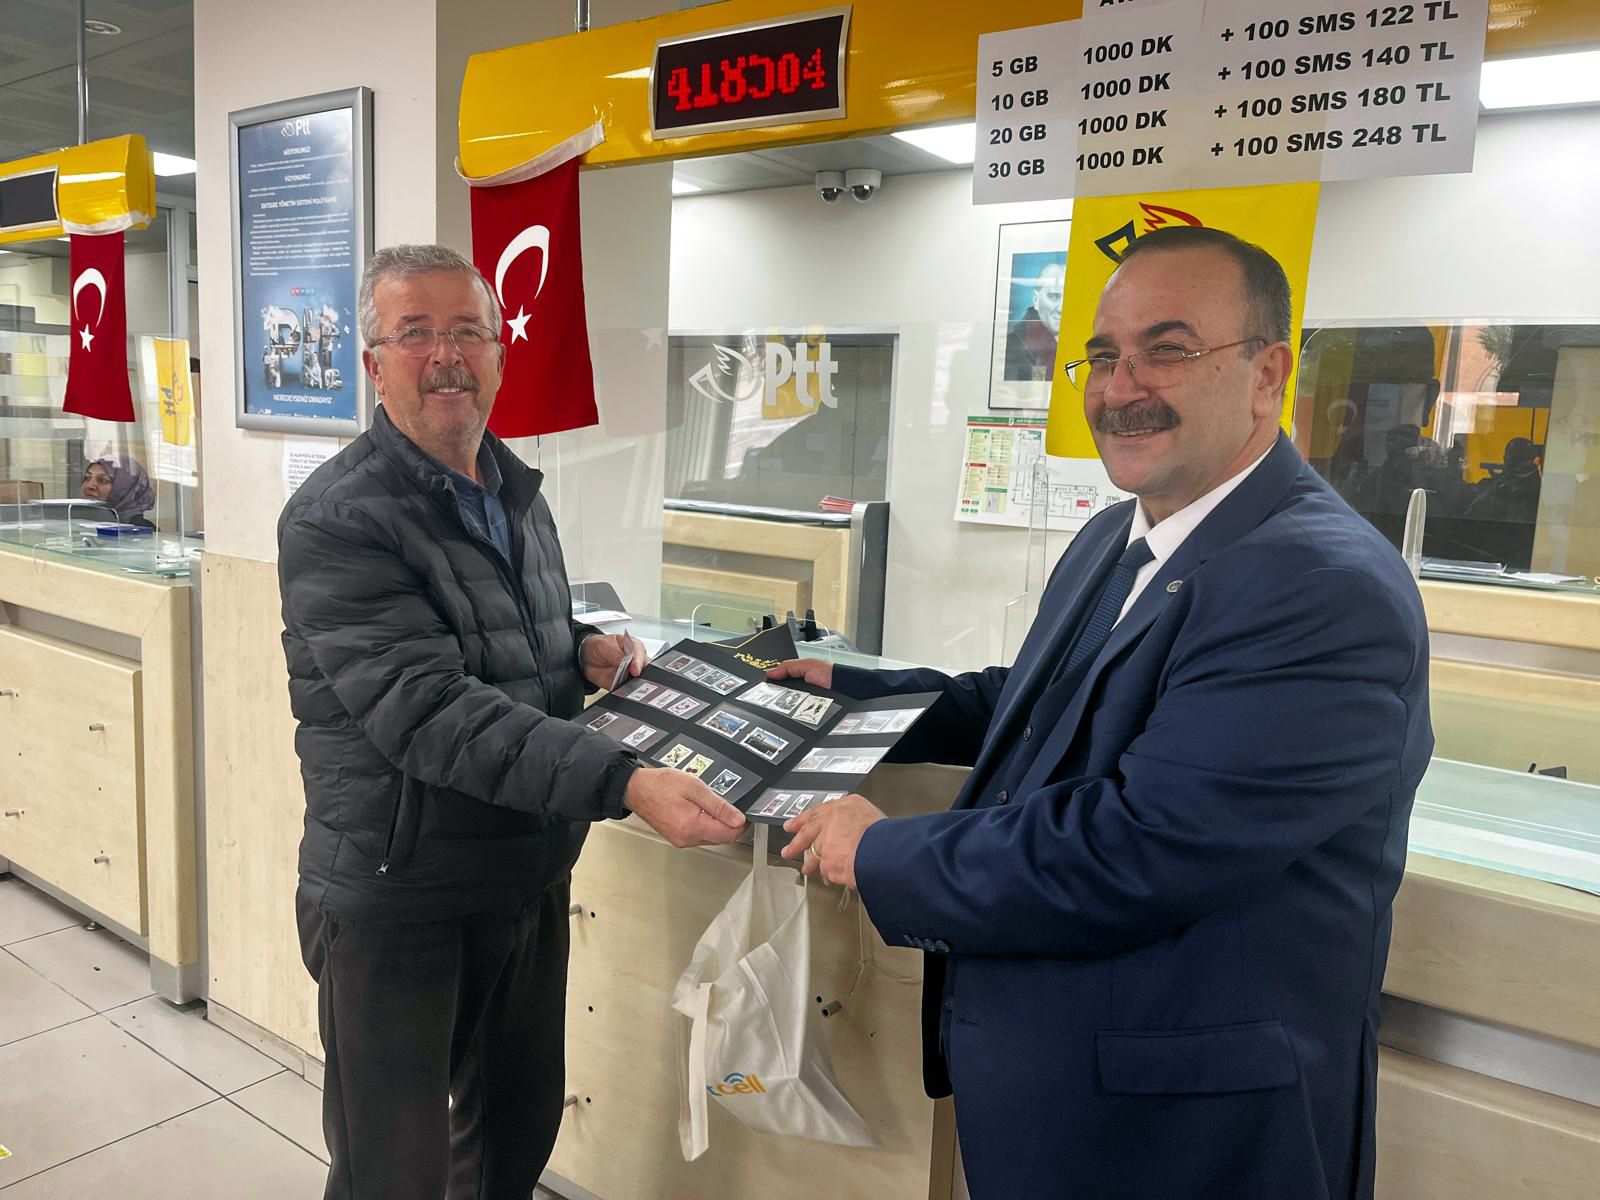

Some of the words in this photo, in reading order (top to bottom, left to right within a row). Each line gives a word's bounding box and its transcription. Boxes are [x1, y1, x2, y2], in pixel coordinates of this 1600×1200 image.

[992, 61, 1003, 78] 5
[1009, 56, 1038, 74] GB
[1084, 42, 1134, 65] 1000
[1140, 35, 1173, 56] DK
[1221, 29, 1234, 42] +
[1244, 20, 1290, 41] 100
[1298, 12, 1355, 36] SMS
[1366, 5, 1414, 28] 122
[1424, 0, 1459, 22] TL
[991, 94, 1014, 111] 10
[1020, 89, 1048, 108] GB
[1080, 79, 1131, 101] 1000
[1139, 73, 1171, 93] DK
[1217, 67, 1231, 81] +
[1240, 59, 1286, 81] 100
[1294, 51, 1351, 75] SMS
[1361, 46, 1410, 68] 140
[1420, 42, 1455, 62] TL
[989, 128, 1013, 146] 20
[1019, 124, 1047, 142] GB
[1078, 115, 1128, 136] 1000
[1136, 110, 1168, 130] DK
[1214, 105, 1227, 119] +
[1237, 98, 1282, 119] 100
[1291, 91, 1347, 114] SMS
[1357, 86, 1406, 107] 180
[1416, 82, 1451, 102] TL
[988, 161, 1011, 178] 30
[1017, 159, 1045, 176] GB
[1075, 151, 1125, 171] 1000
[1133, 146, 1163, 166] DK
[1211, 143, 1224, 157] +
[1233, 136, 1278, 157] 100
[1287, 130, 1342, 153] SMS
[1352, 127, 1402, 148] 248
[1412, 123, 1447, 143] TL
[765, 342, 838, 408] Ptt
